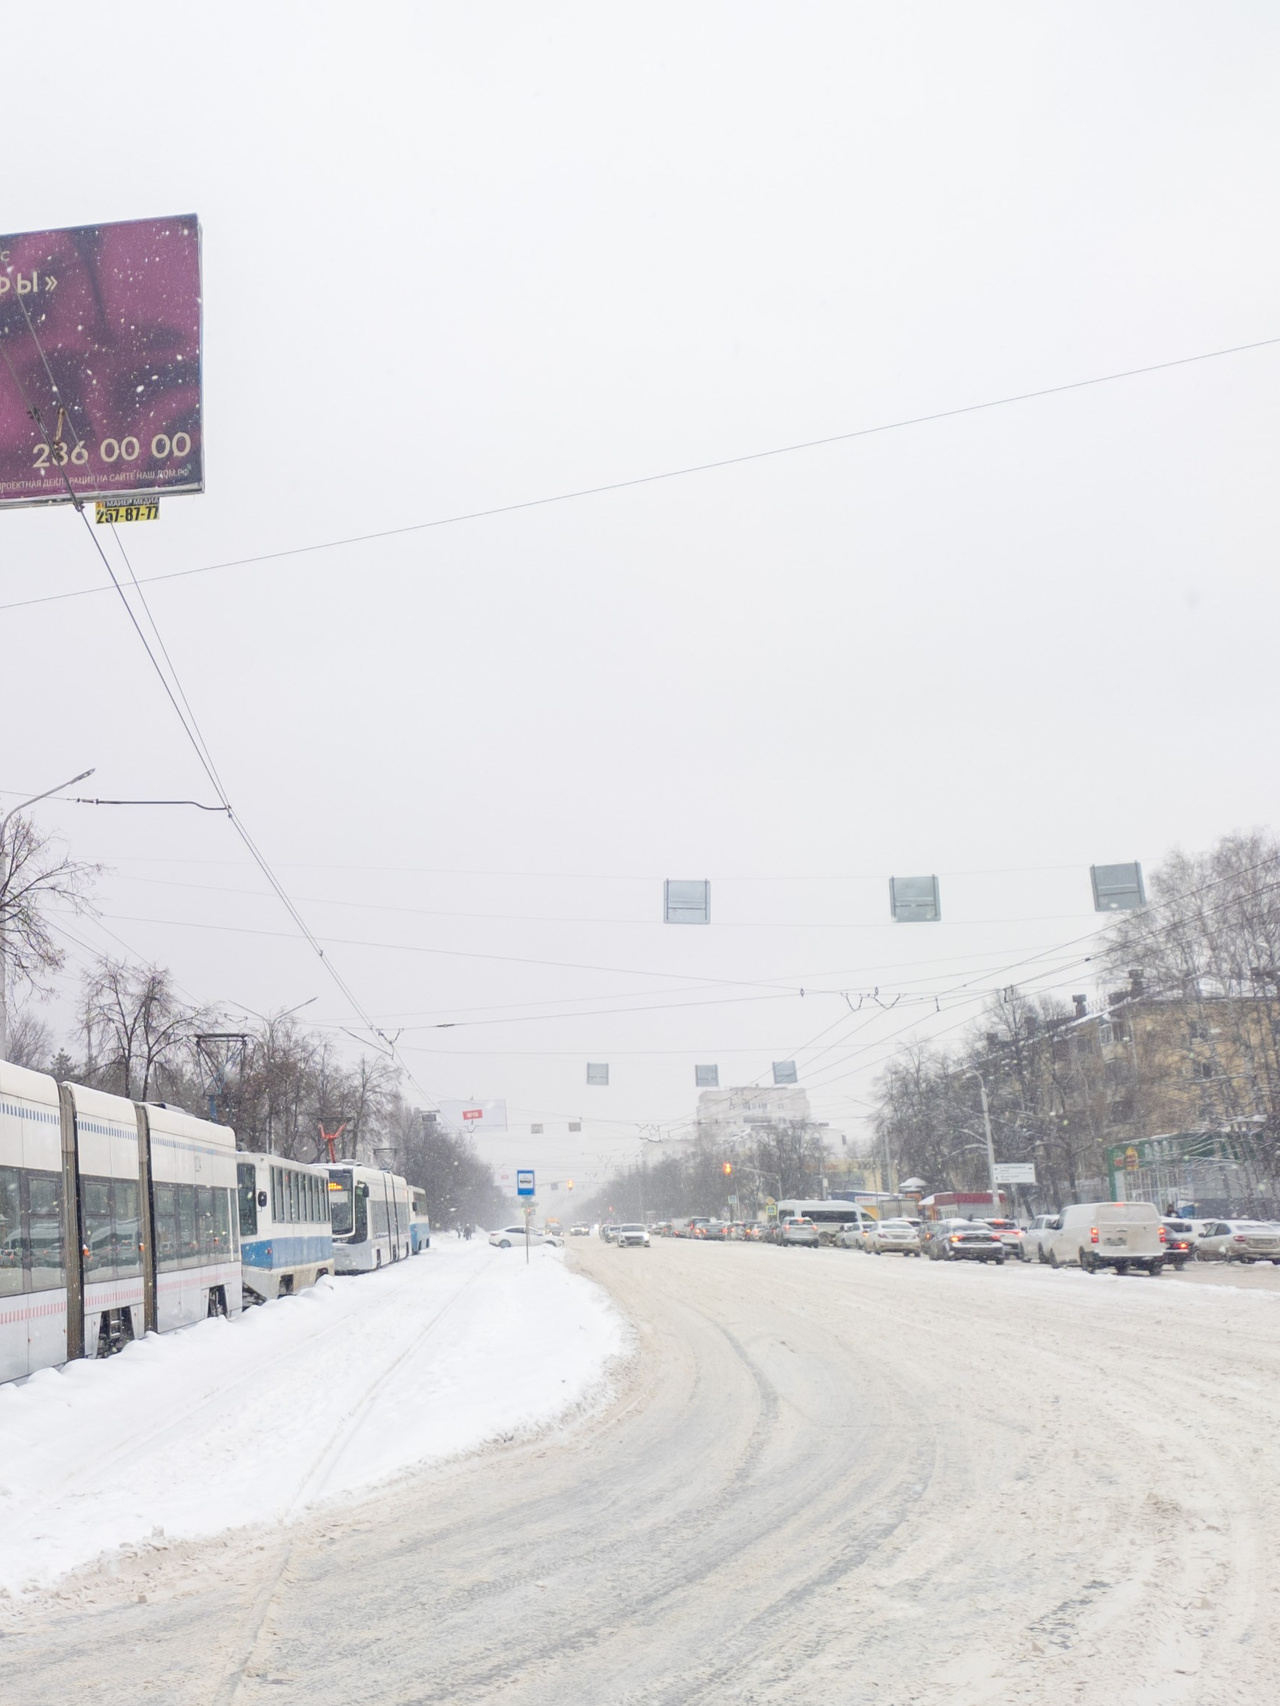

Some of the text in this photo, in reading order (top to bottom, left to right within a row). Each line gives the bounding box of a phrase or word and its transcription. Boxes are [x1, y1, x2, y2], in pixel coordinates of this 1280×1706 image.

[32, 432, 191, 468] 236 00 00
[43, 475, 95, 488] ДЕКЛРАЦИЯ
[96, 505, 159, 525] 257-87-77
